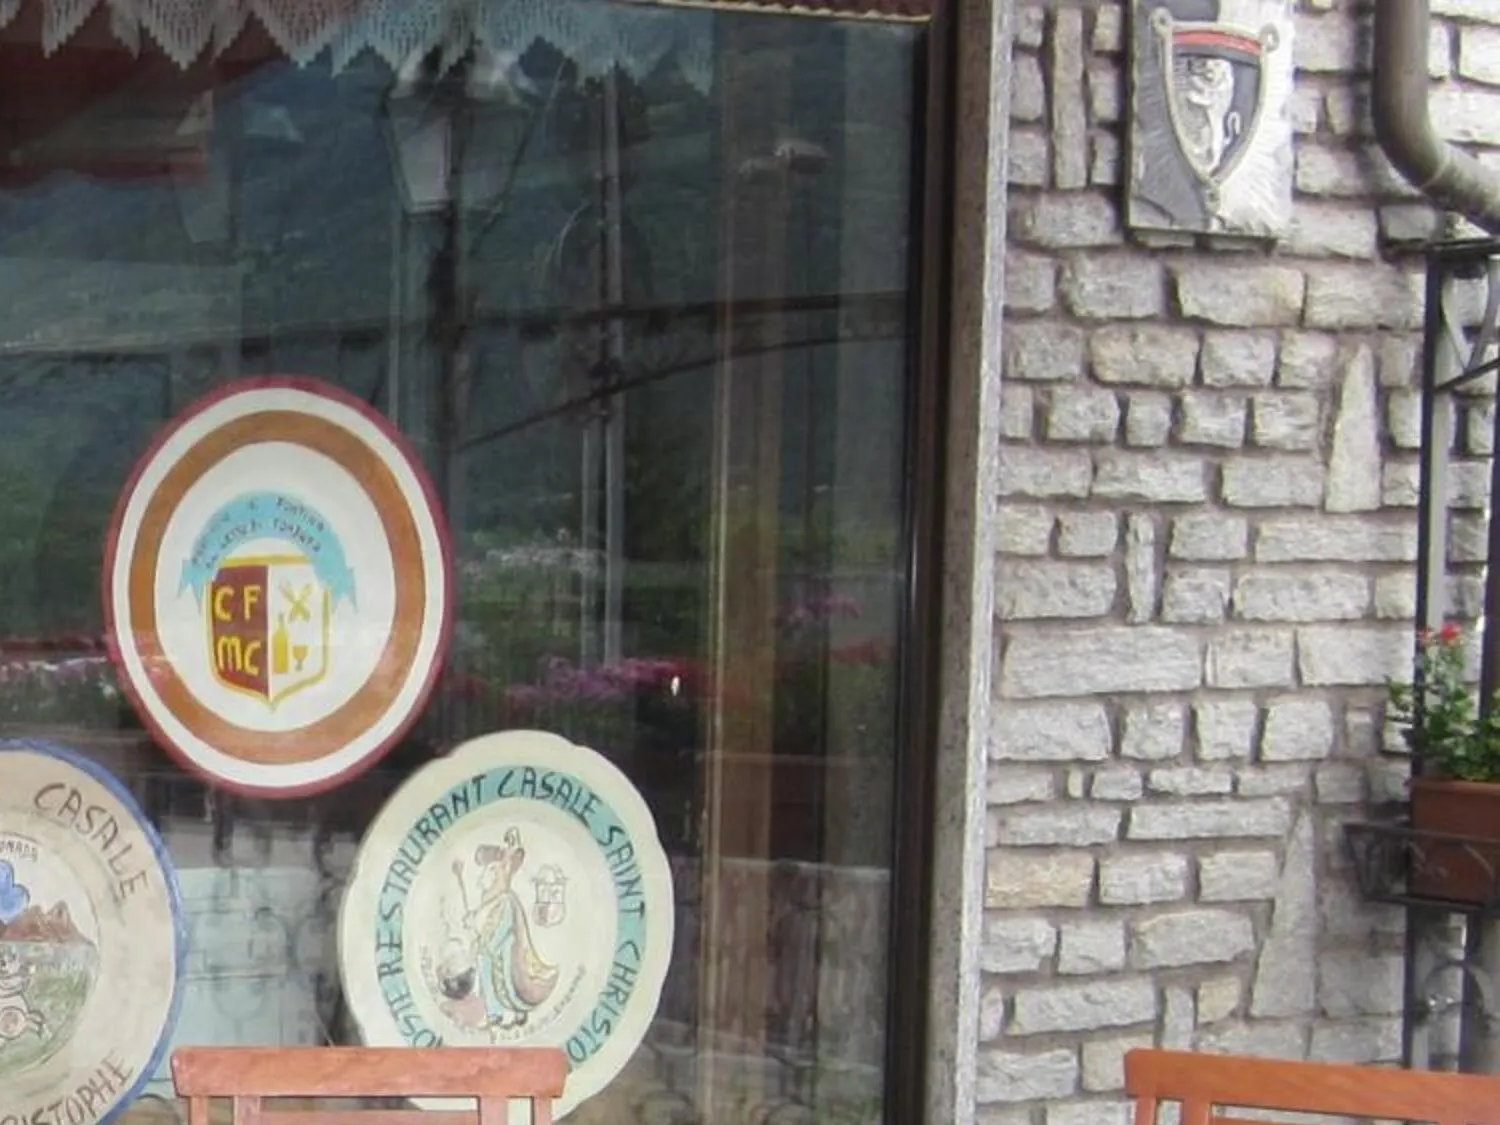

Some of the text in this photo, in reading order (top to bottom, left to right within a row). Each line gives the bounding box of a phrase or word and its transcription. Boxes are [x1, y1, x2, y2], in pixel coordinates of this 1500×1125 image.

[217, 635, 261, 676] MC
[34, 782, 150, 900] CASALE
[497, 766, 602, 829] CASALE
[375, 774, 487, 981] RESTAURANT
[597, 825, 646, 920] SAINT
[565, 940, 641, 1063] CHRISTO
